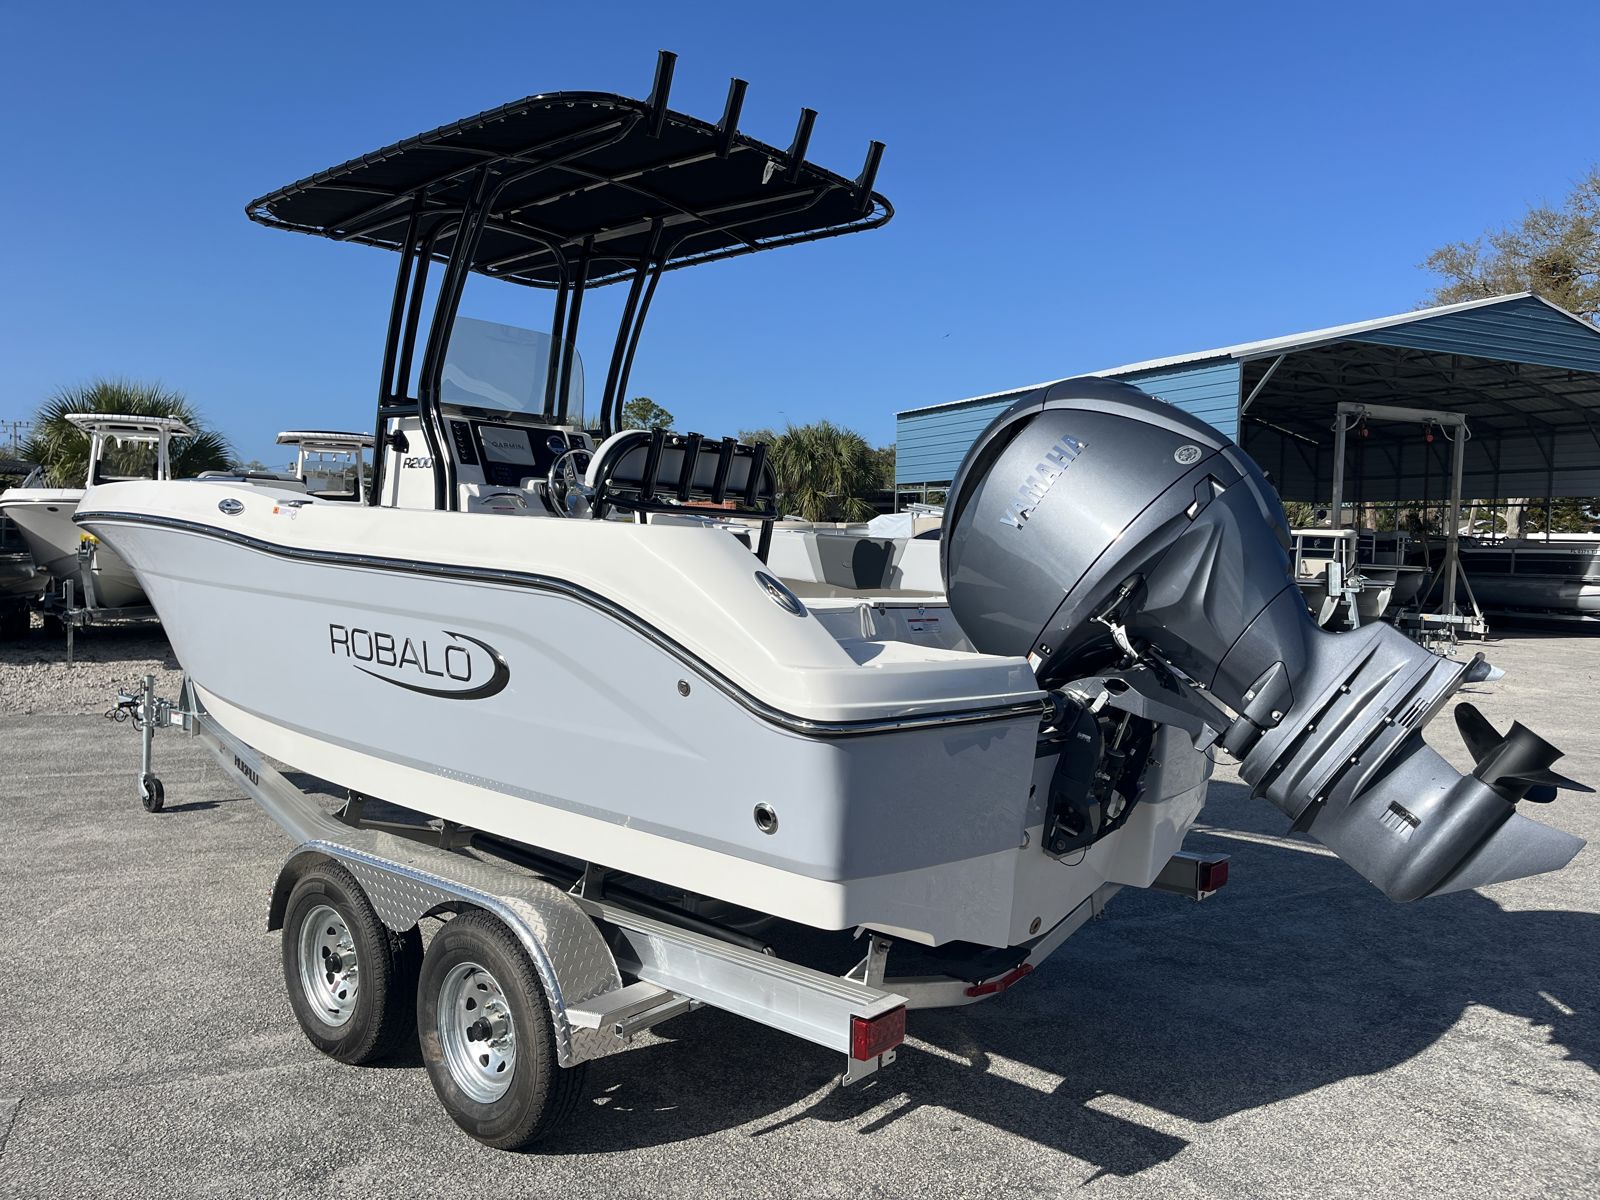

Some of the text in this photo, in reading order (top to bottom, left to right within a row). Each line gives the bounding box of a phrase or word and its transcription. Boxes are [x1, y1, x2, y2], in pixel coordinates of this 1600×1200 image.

[402, 457, 432, 469] R200
[491, 441, 526, 450] GARMIN
[1000, 434, 1089, 531] YAMAHA
[329, 623, 472, 682] ROBALO
